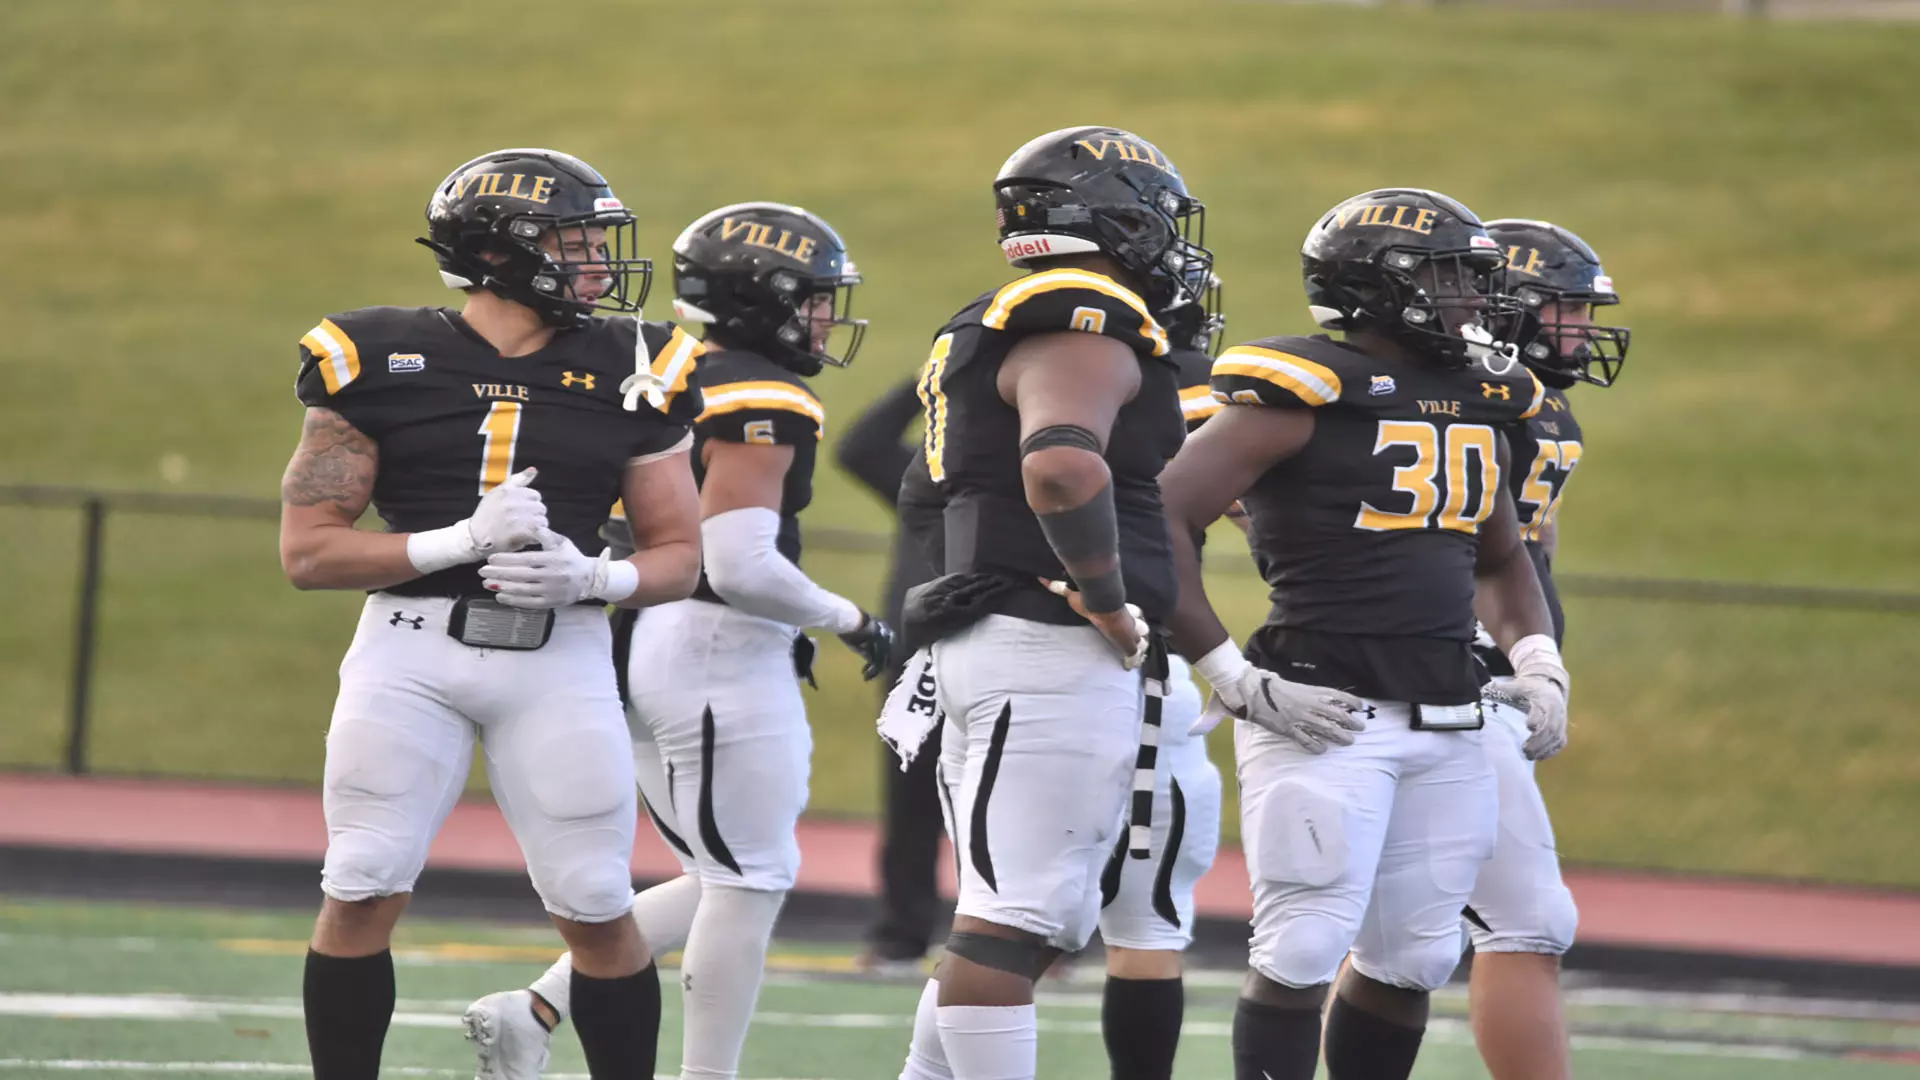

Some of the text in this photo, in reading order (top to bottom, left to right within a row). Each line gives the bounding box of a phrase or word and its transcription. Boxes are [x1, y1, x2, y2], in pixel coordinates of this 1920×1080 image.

[454, 173, 555, 204] VILLE
[1336, 204, 1439, 235] VILLE
[720, 217, 817, 264] VILLE
[390, 358, 422, 368] PSAC
[472, 383, 530, 401] VILLE
[1416, 399, 1461, 417] VILLE
[477, 400, 523, 497] 1
[1353, 419, 1500, 534] 30
